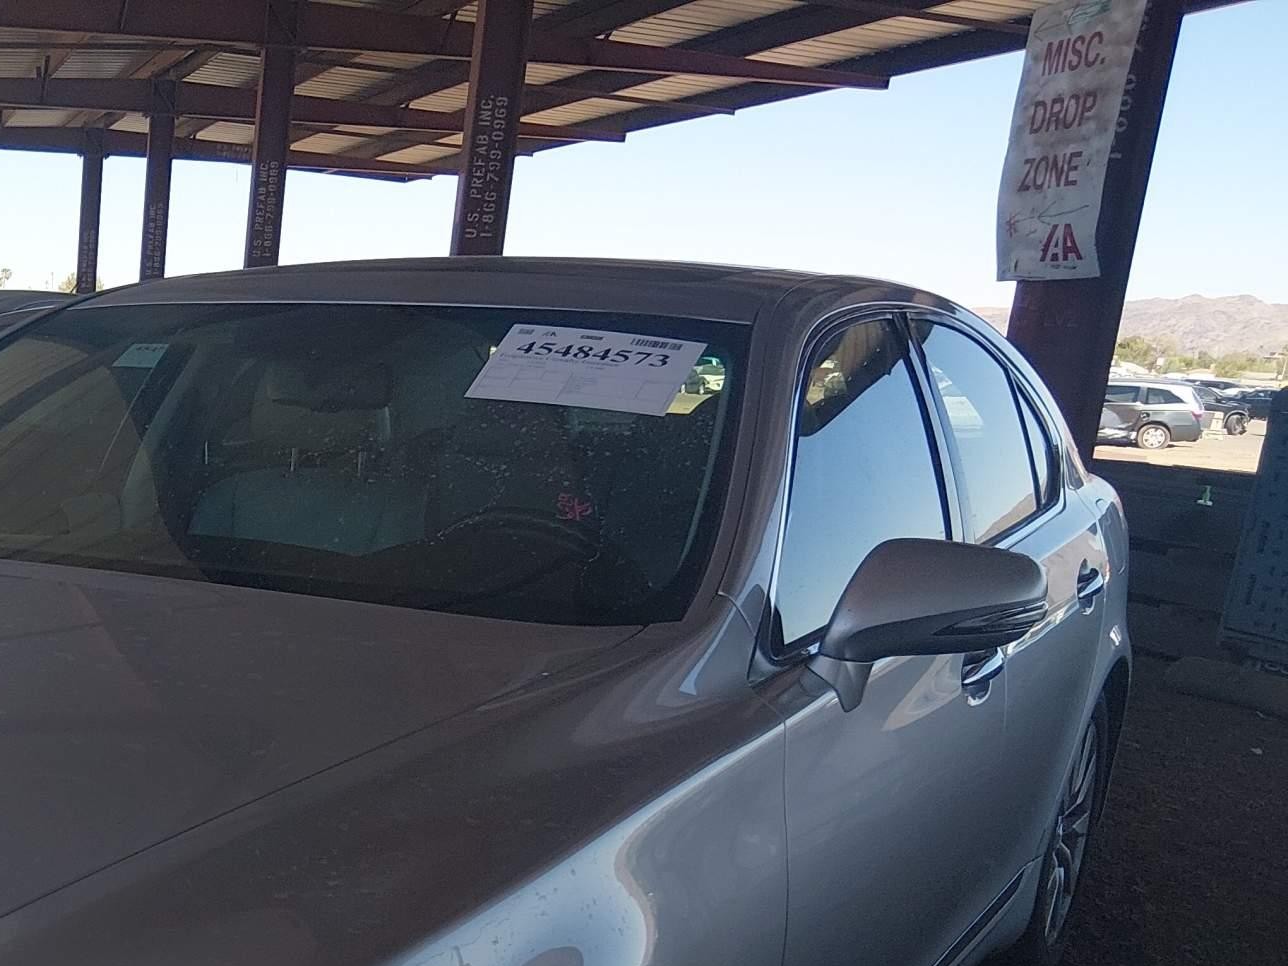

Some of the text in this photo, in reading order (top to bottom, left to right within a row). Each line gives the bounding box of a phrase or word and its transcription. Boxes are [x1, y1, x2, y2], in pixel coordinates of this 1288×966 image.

[1041, 31, 1106, 77] MISC.
[478, 94, 495, 126] INC.
[1028, 91, 1099, 136] DROP
[470, 134, 489, 199] PREFAB
[1016, 150, 1084, 193] ZONE
[516, 340, 671, 368] 45484573
